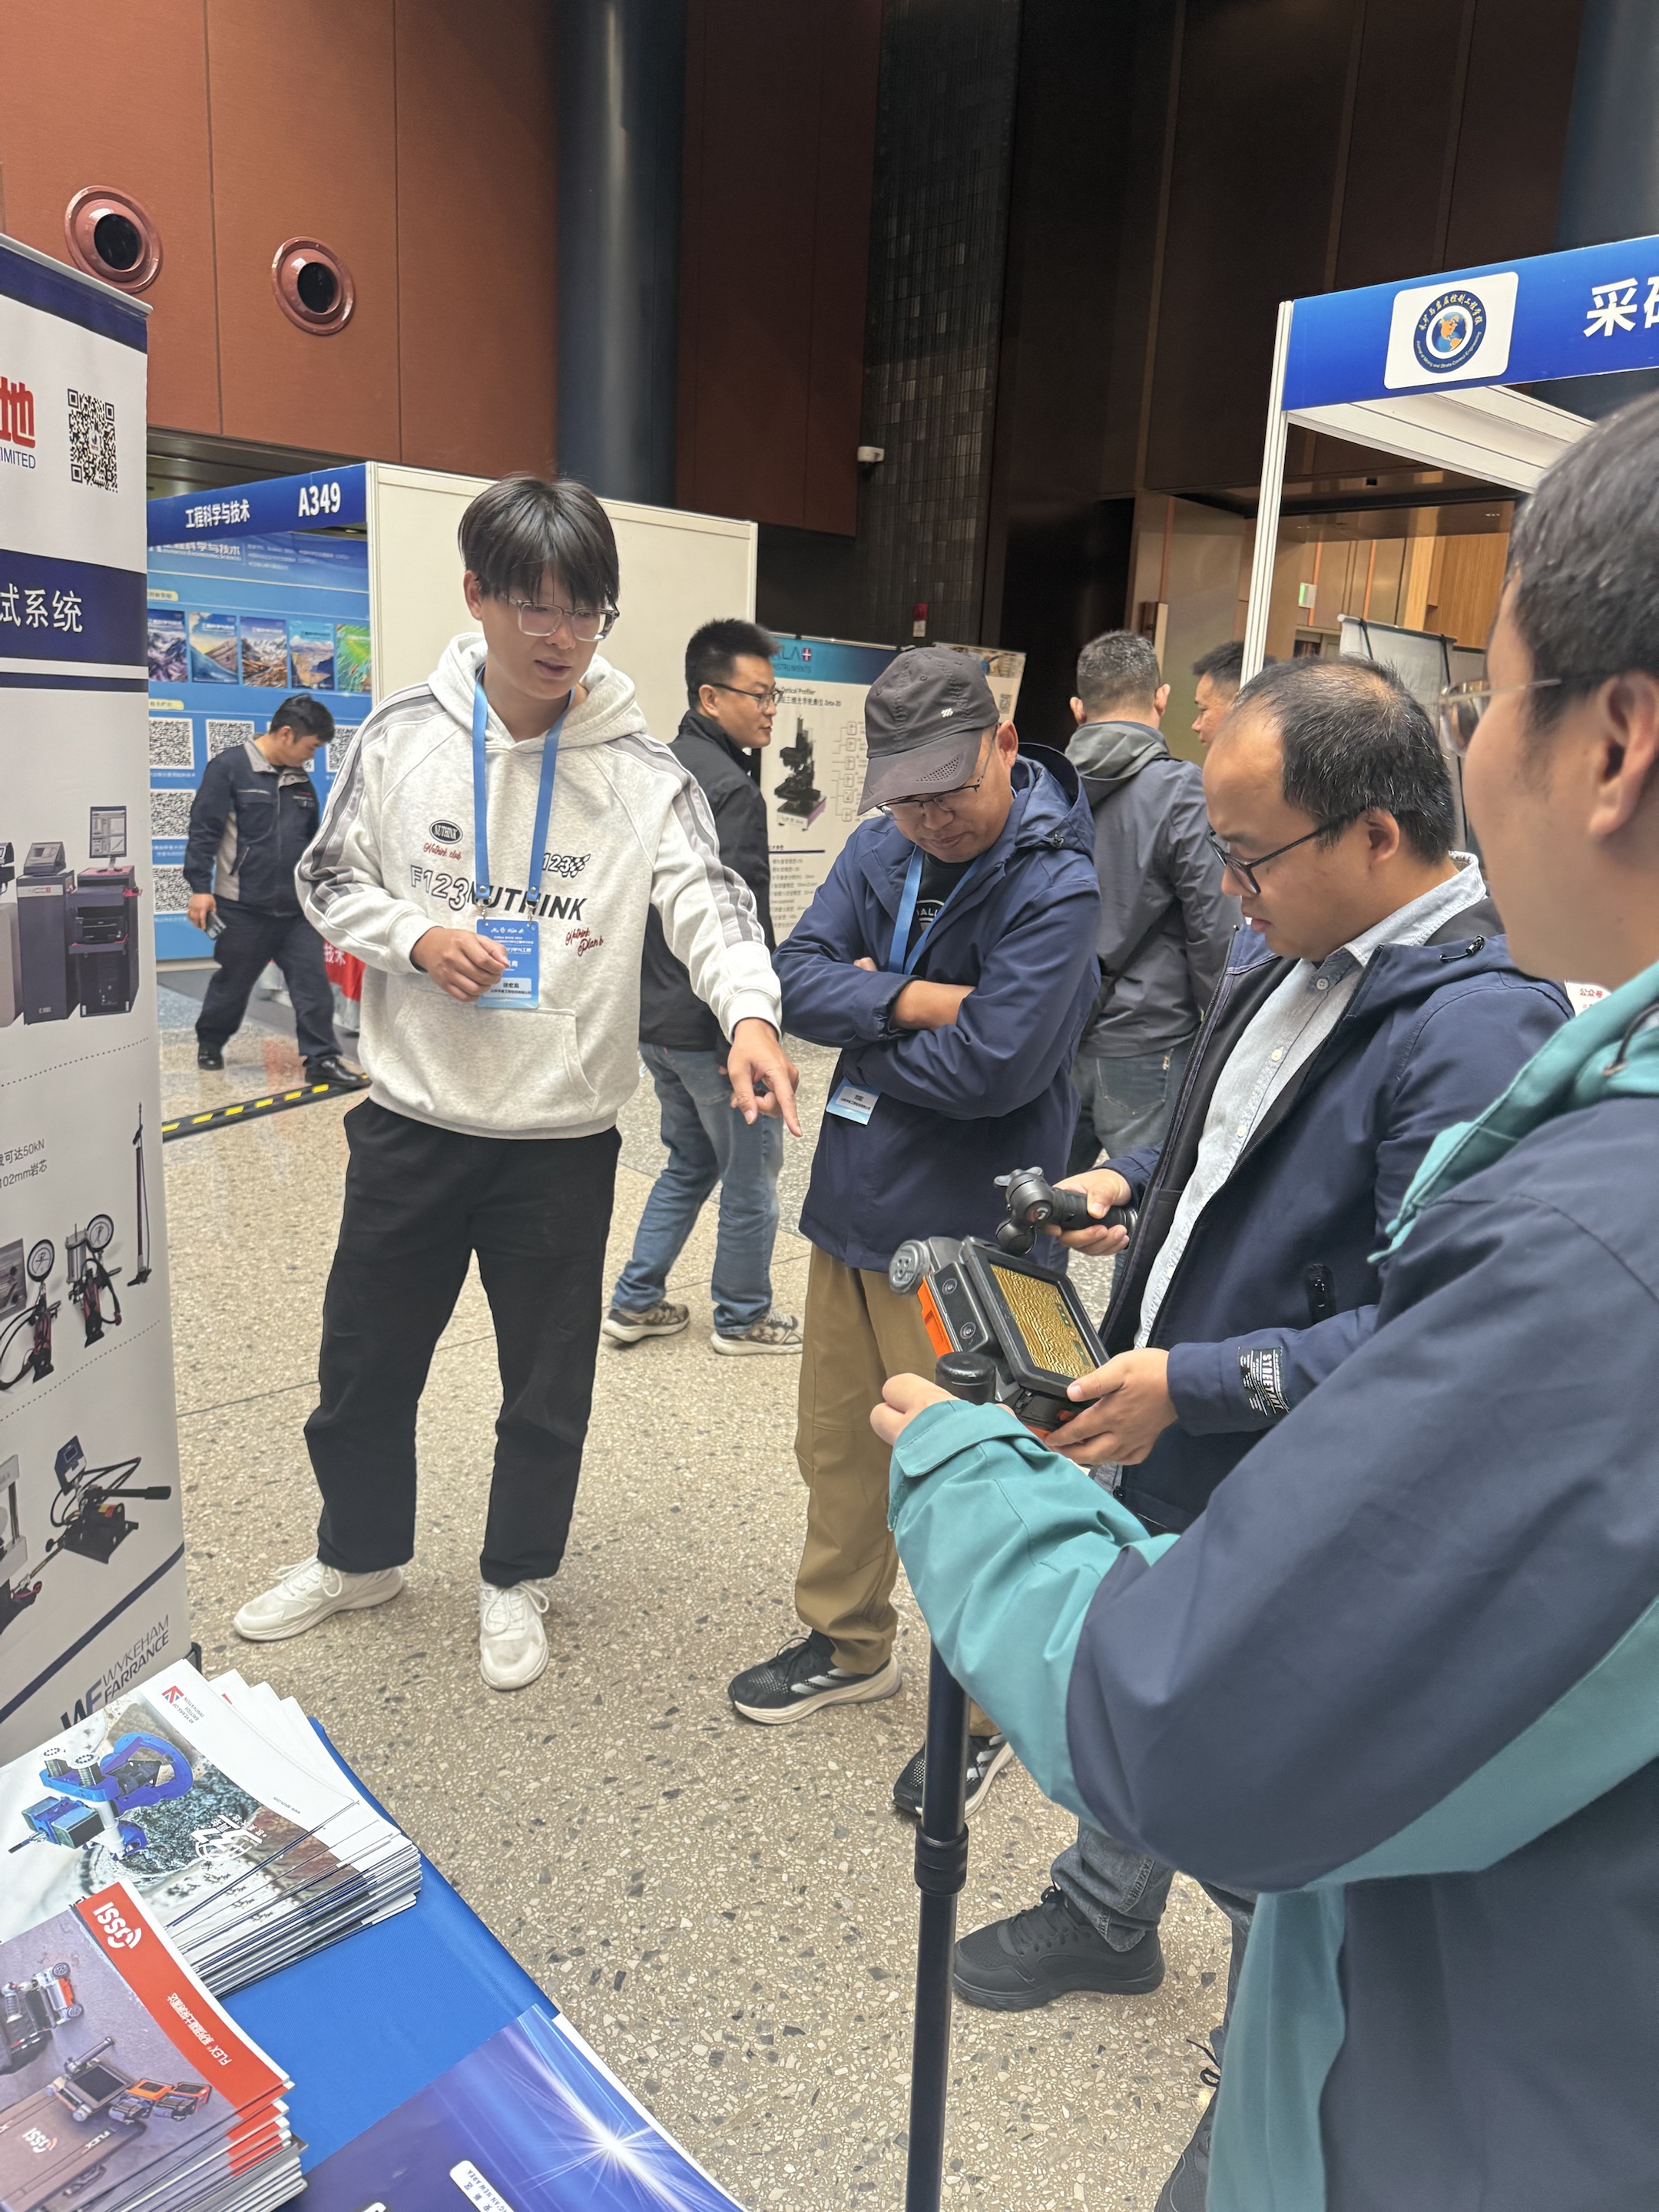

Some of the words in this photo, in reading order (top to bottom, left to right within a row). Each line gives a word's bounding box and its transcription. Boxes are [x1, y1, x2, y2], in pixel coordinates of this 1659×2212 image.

[0, 447, 36, 469] IMITED
[185, 498, 250, 528] 工程科学与技术
[298, 482, 341, 518] A349
[434, 824, 459, 840] NUTHINK
[410, 865, 470, 912] F123
[102, 1614, 169, 1687] WYKEHAM
[104, 1630, 170, 1704] FARRANCE
[467, 2169, 482, 2184] AREA
[479, 2184, 493, 2197] NEW
